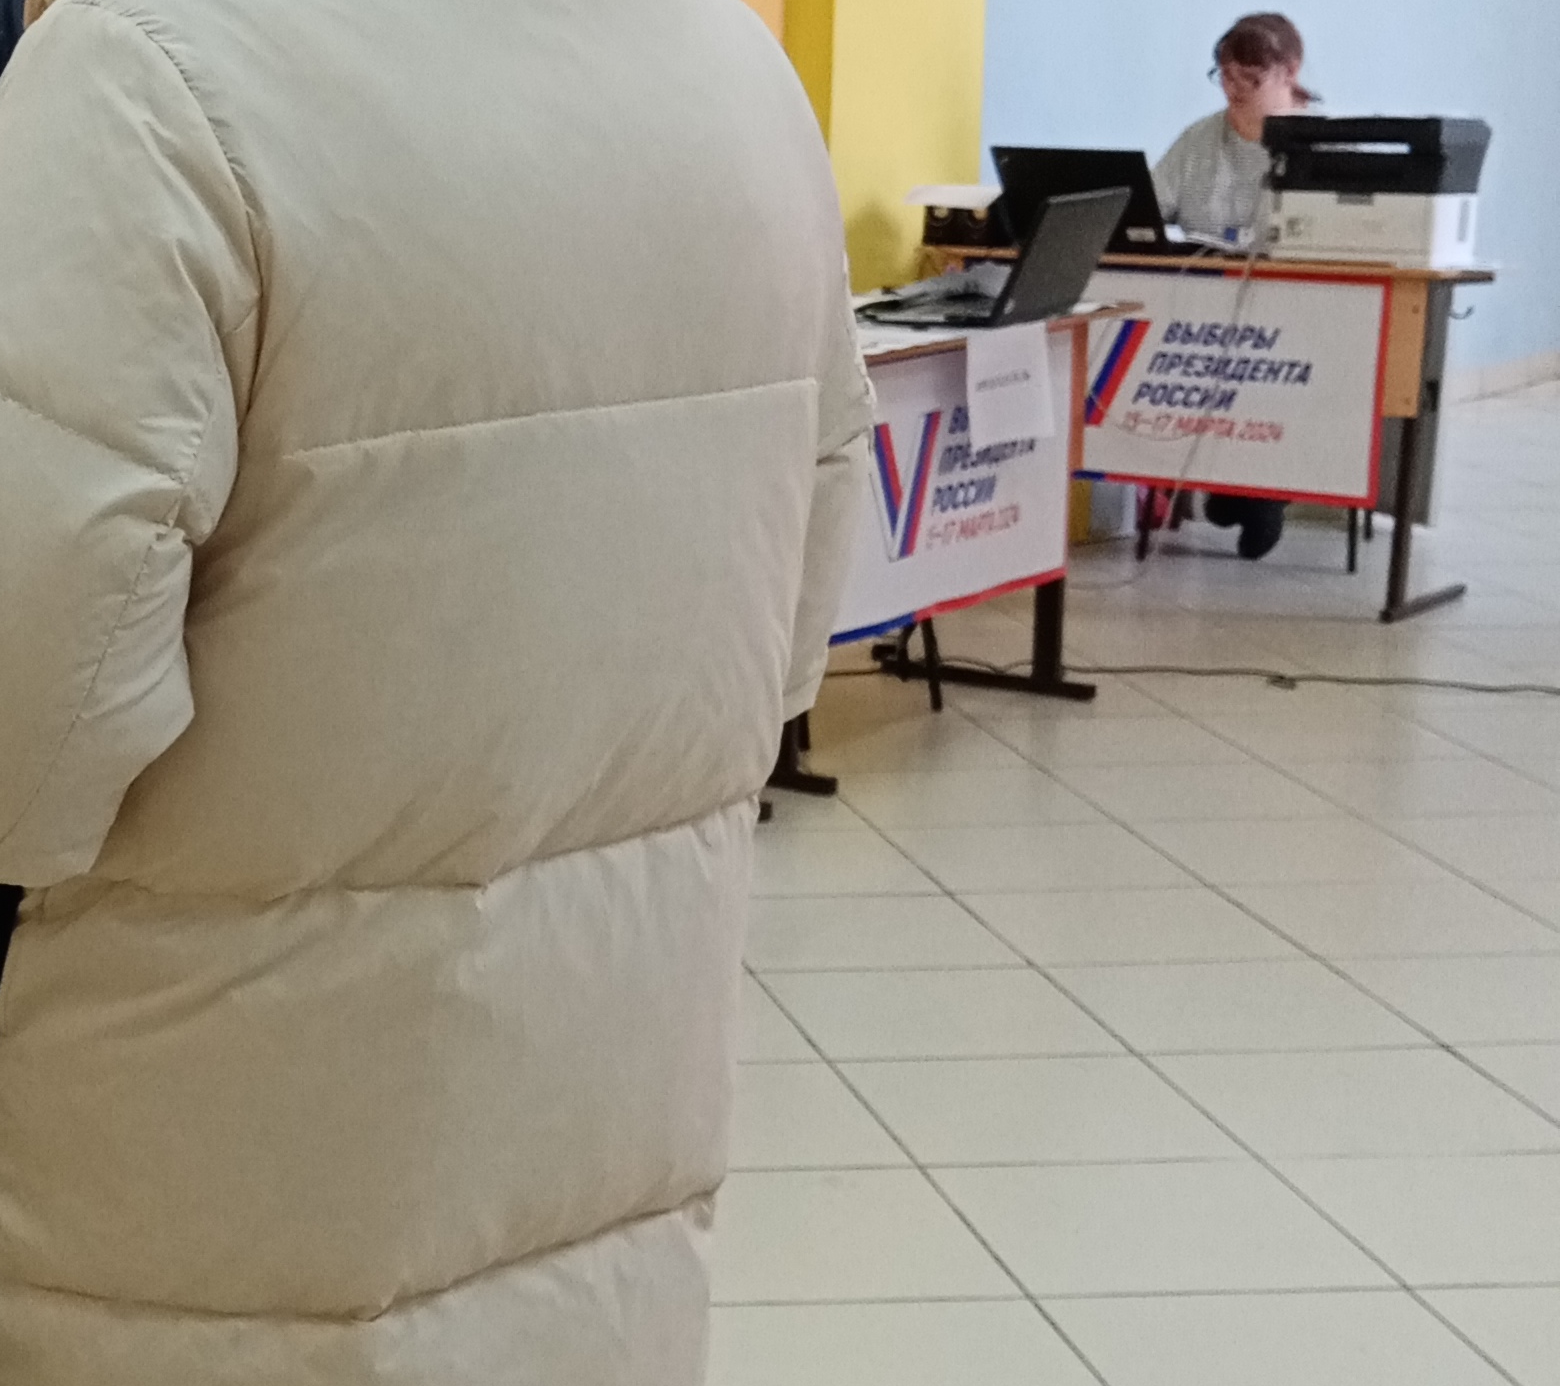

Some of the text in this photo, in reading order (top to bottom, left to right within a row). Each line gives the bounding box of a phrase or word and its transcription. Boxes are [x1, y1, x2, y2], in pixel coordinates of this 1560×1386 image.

[1163, 320, 1281, 350] ВЫБОРЫ
[1148, 352, 1313, 385] ПРЕЗИДЕНТА
[1132, 383, 1237, 411] РОССИИ
